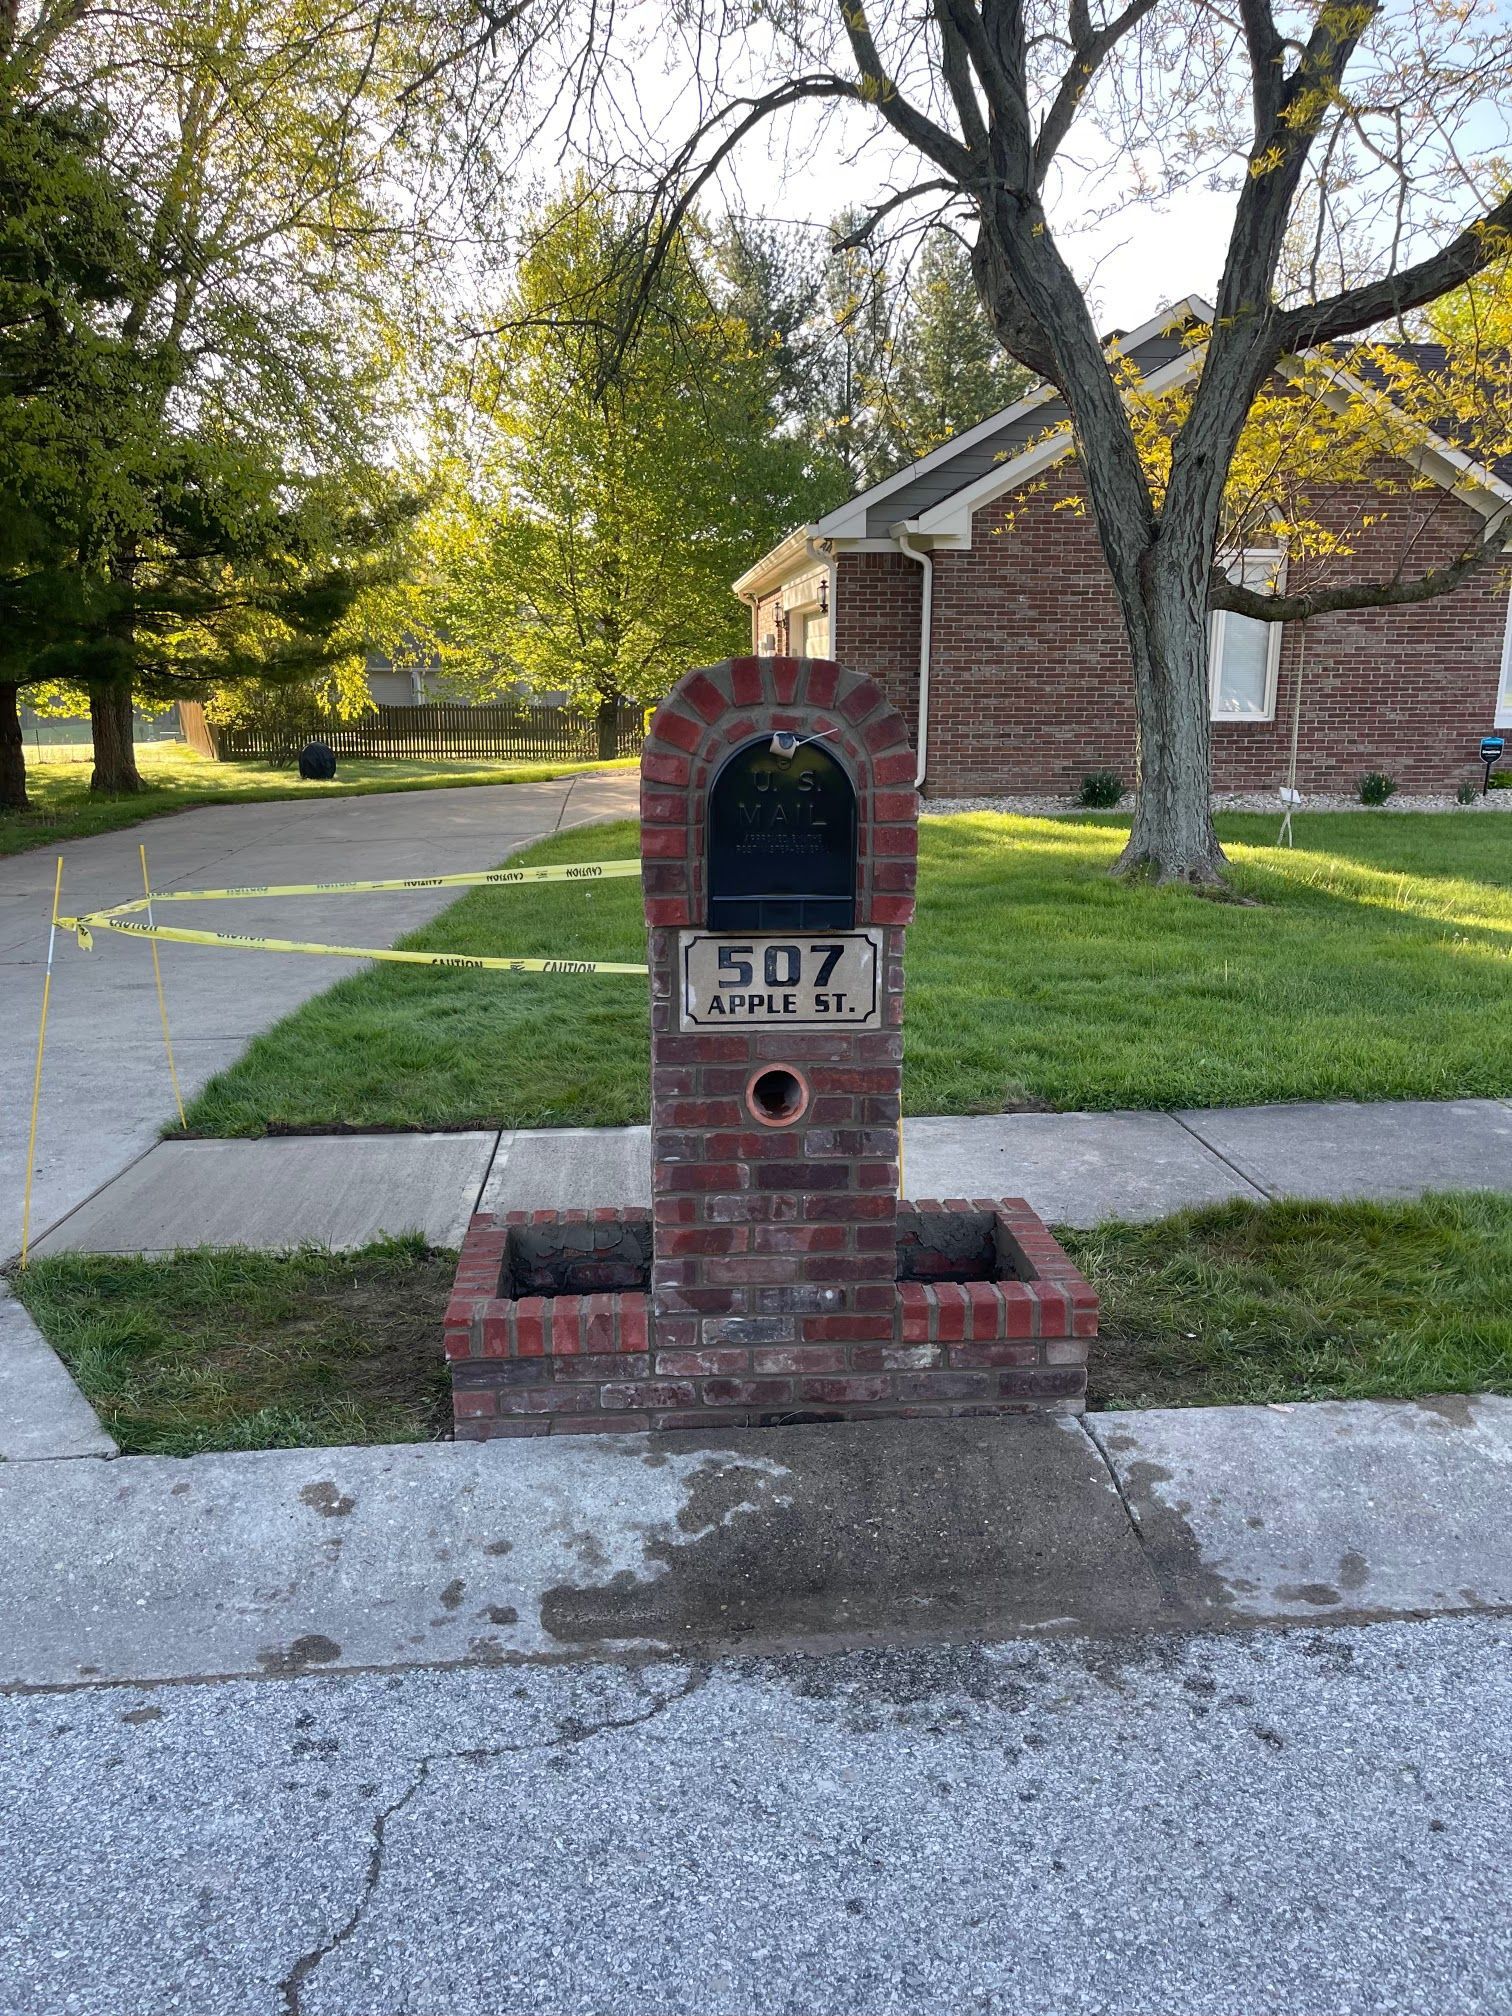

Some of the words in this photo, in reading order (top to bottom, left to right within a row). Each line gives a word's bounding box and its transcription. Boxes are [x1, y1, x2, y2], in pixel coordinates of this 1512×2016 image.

[739, 803, 828, 825] MAIL
[486, 872, 524, 882] CAUTION
[566, 866, 602, 877] CAUTION
[543, 961, 596, 972] CAUTION
[719, 945, 845, 988] 507
[707, 994, 797, 1014] APPLE
[815, 993, 855, 1013] ST.
